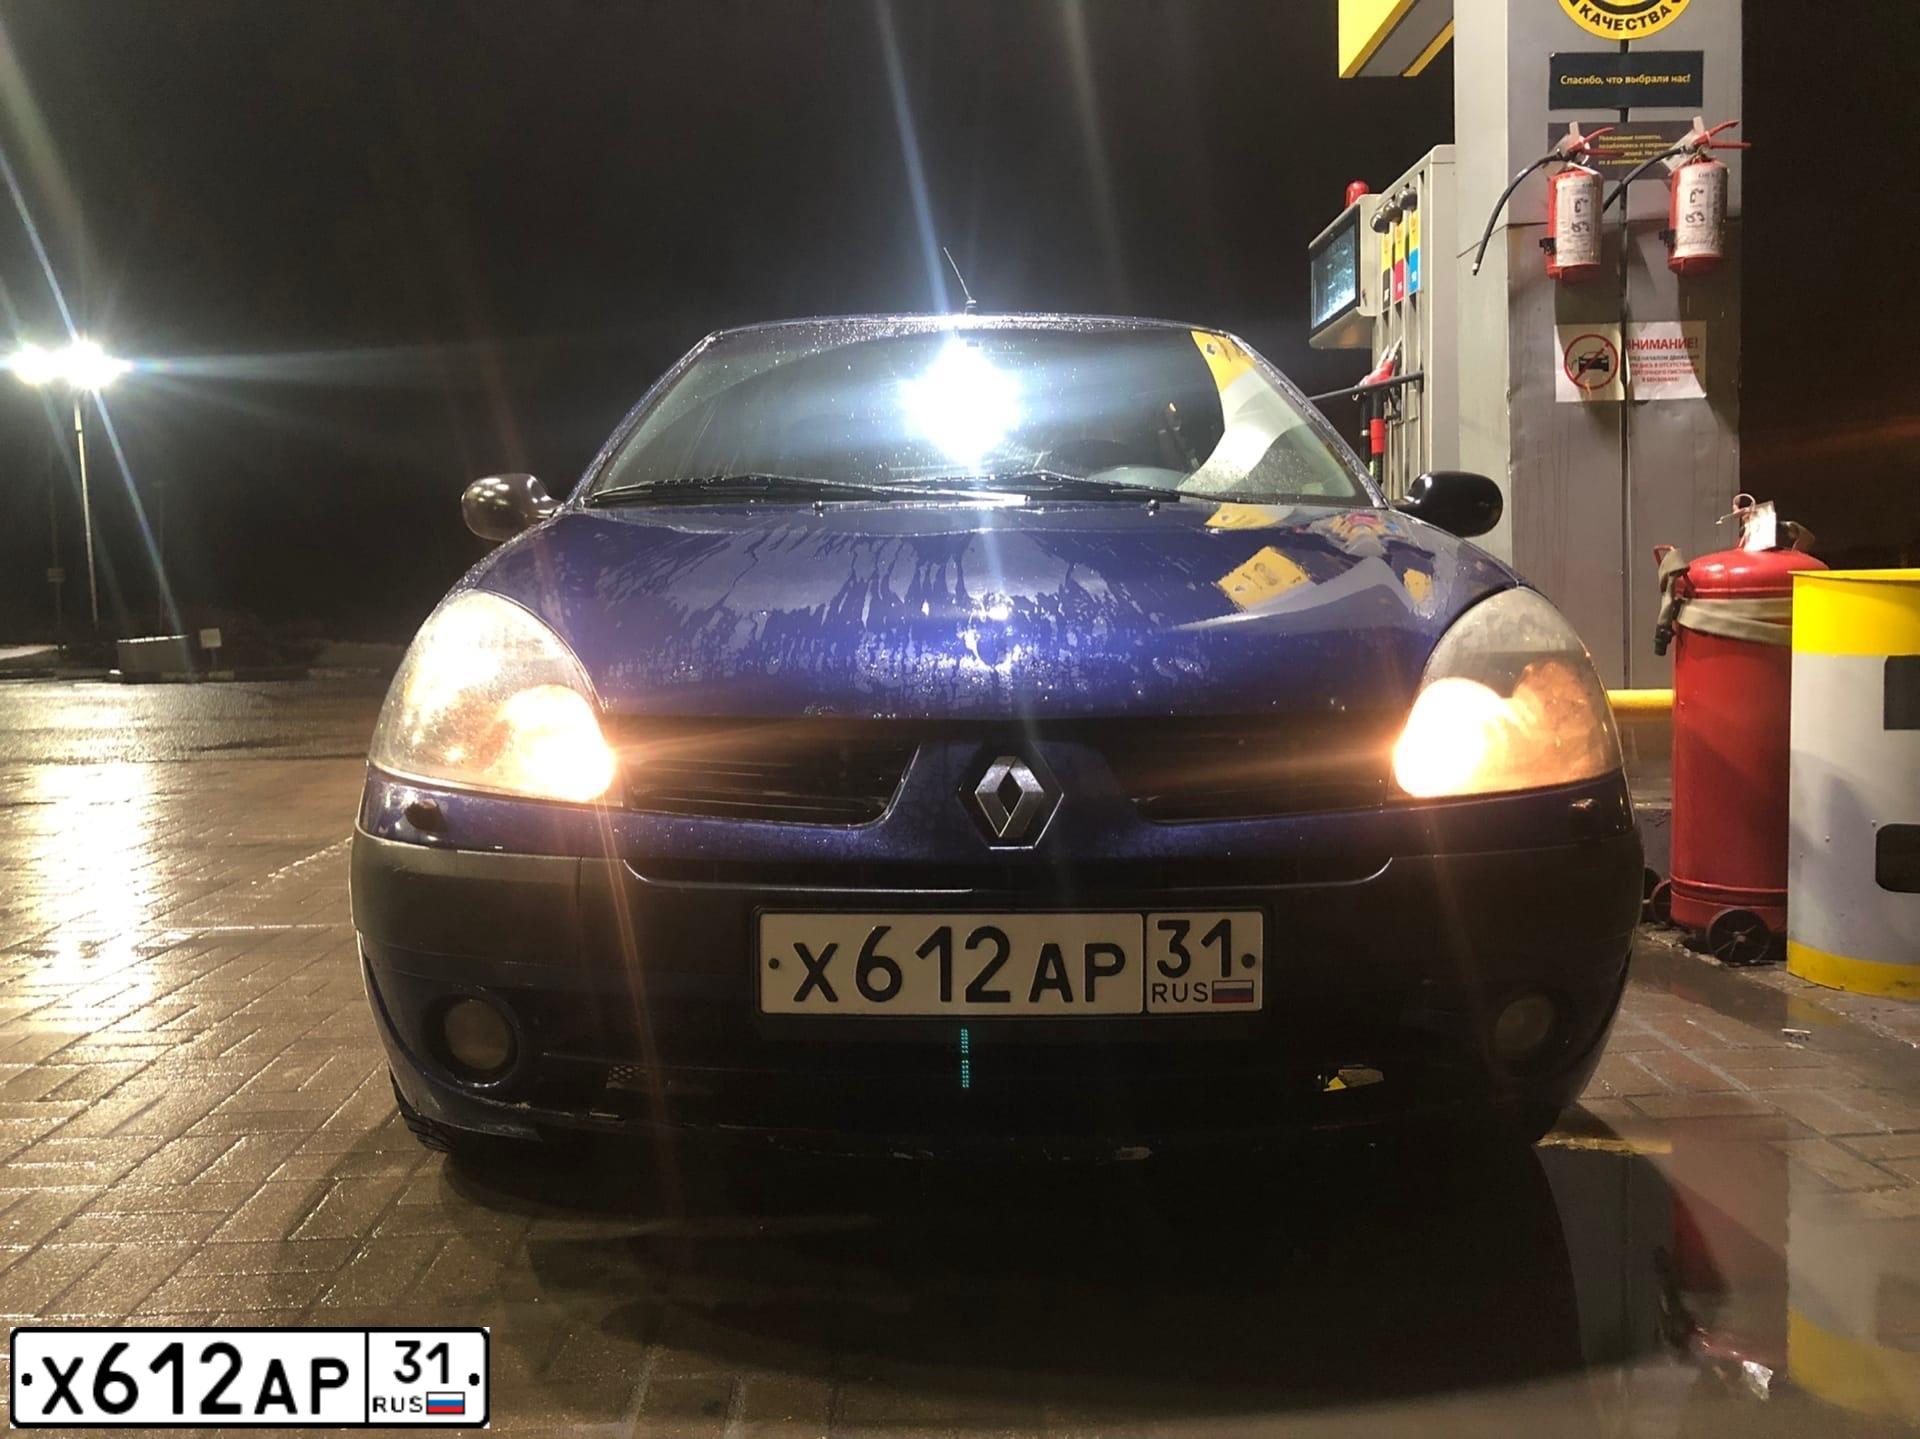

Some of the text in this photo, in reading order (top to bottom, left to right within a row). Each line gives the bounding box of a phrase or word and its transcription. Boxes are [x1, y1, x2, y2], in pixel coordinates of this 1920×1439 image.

[1579, 4, 1671, 31] КАЧЕСТВА
[1560, 73, 1690, 86] Спасибо, что выбрали нас!
[1156, 919, 1232, 978] 31
[1152, 982, 1208, 1003] RUS
